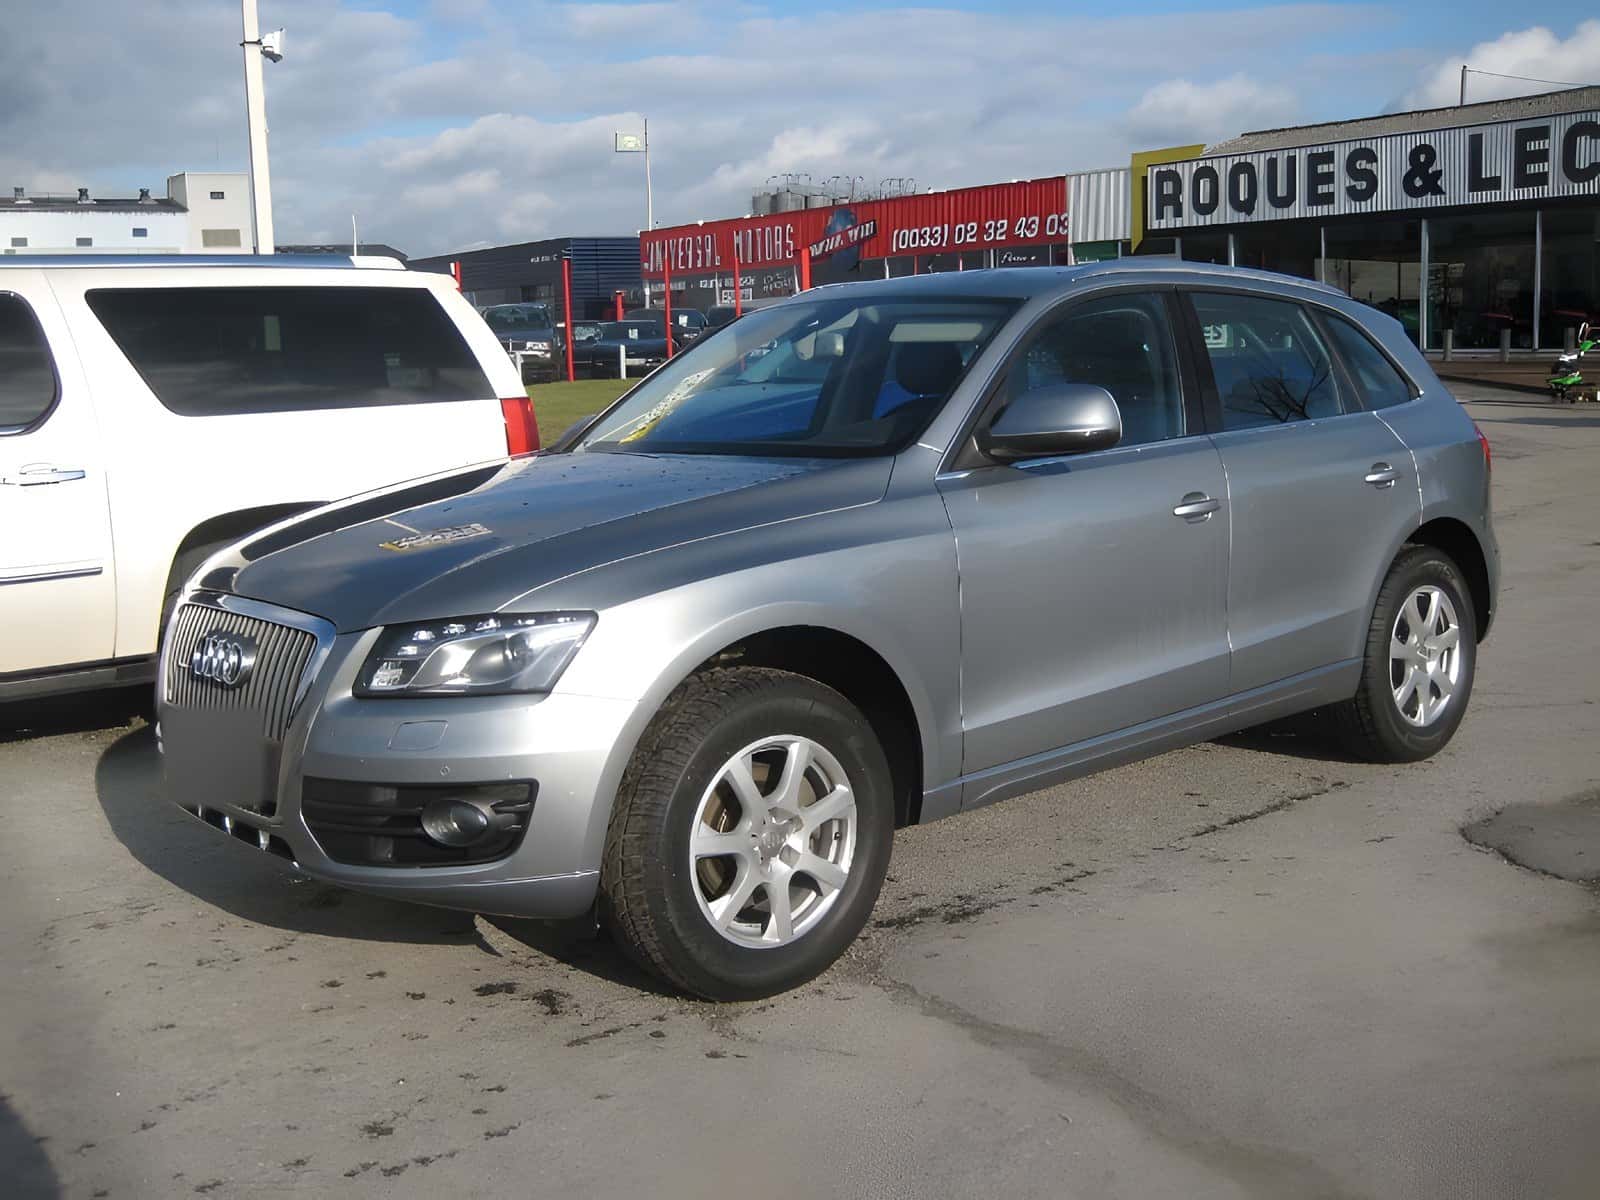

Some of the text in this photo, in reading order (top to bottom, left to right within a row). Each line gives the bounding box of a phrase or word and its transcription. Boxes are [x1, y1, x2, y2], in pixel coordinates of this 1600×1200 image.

[1155, 120, 1600, 221] ROQUES & LEC
[734, 223, 794, 264] MOTORS
[892, 223, 949, 252] (0033)
[954, 222, 978, 245] 02
[983, 219, 1008, 243] 32
[1014, 215, 1040, 239] 43
